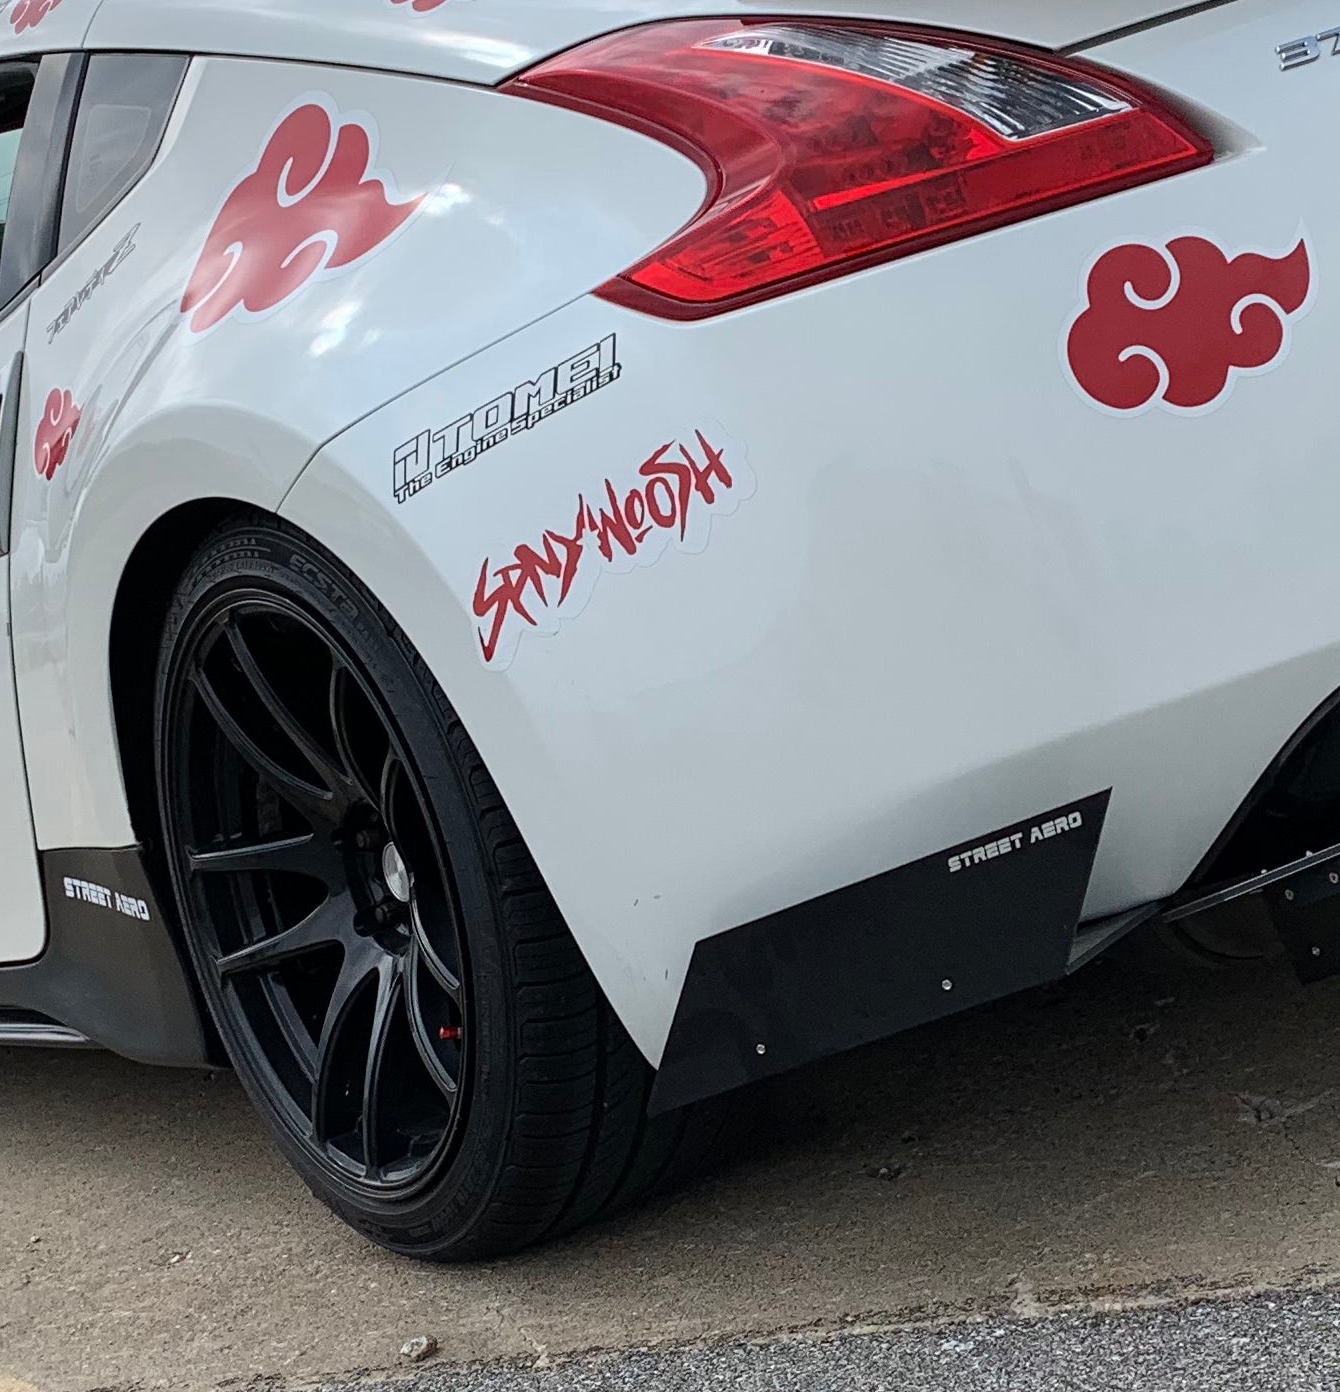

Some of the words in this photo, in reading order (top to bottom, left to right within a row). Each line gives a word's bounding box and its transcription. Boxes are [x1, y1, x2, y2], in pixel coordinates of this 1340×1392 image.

[393, 470, 433, 505] The
[434, 428, 509, 480] Engine
[509, 362, 623, 436] Specialist
[432, 332, 619, 460] TOMEI
[946, 832, 1023, 873] STREET
[1029, 811, 1083, 845] AERO
[63, 876, 114, 911] STREET
[114, 891, 151, 921] AERO
